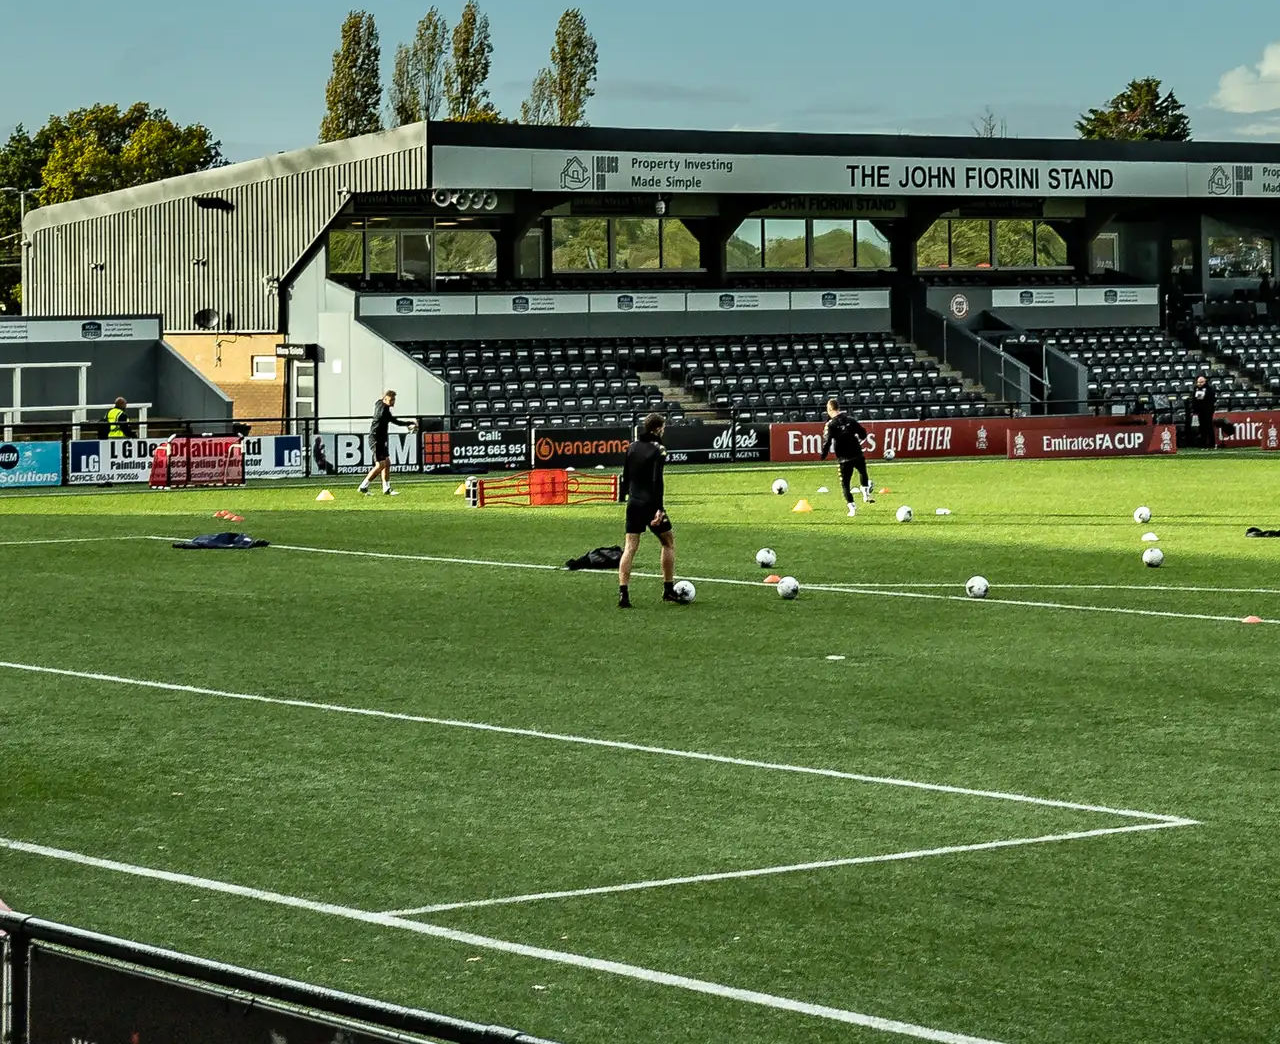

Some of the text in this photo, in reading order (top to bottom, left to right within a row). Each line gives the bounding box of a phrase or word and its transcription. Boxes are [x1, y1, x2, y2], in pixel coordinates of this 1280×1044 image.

[631, 158, 732, 173] Property Investing
[631, 176, 702, 190] Made Simple
[847, 165, 1114, 190] THE JOHN FIORINI STAND
[478, 431, 502, 442] Call:
[884, 427, 952, 452] FLY BETTER
[1042, 432, 1144, 452] Emirates FA CUP
[110, 441, 119, 459] L
[122, 440, 133, 458] G
[453, 443, 526, 457] 01322 665 951
[554, 440, 630, 455] vanarama
[708, 451, 760, 459] ESTATE AGENTS
[81, 455, 99, 472] LG
[110, 458, 146, 471] Painting
[284, 450, 300, 467] LG
[338, 465, 372, 474] PROPERT
